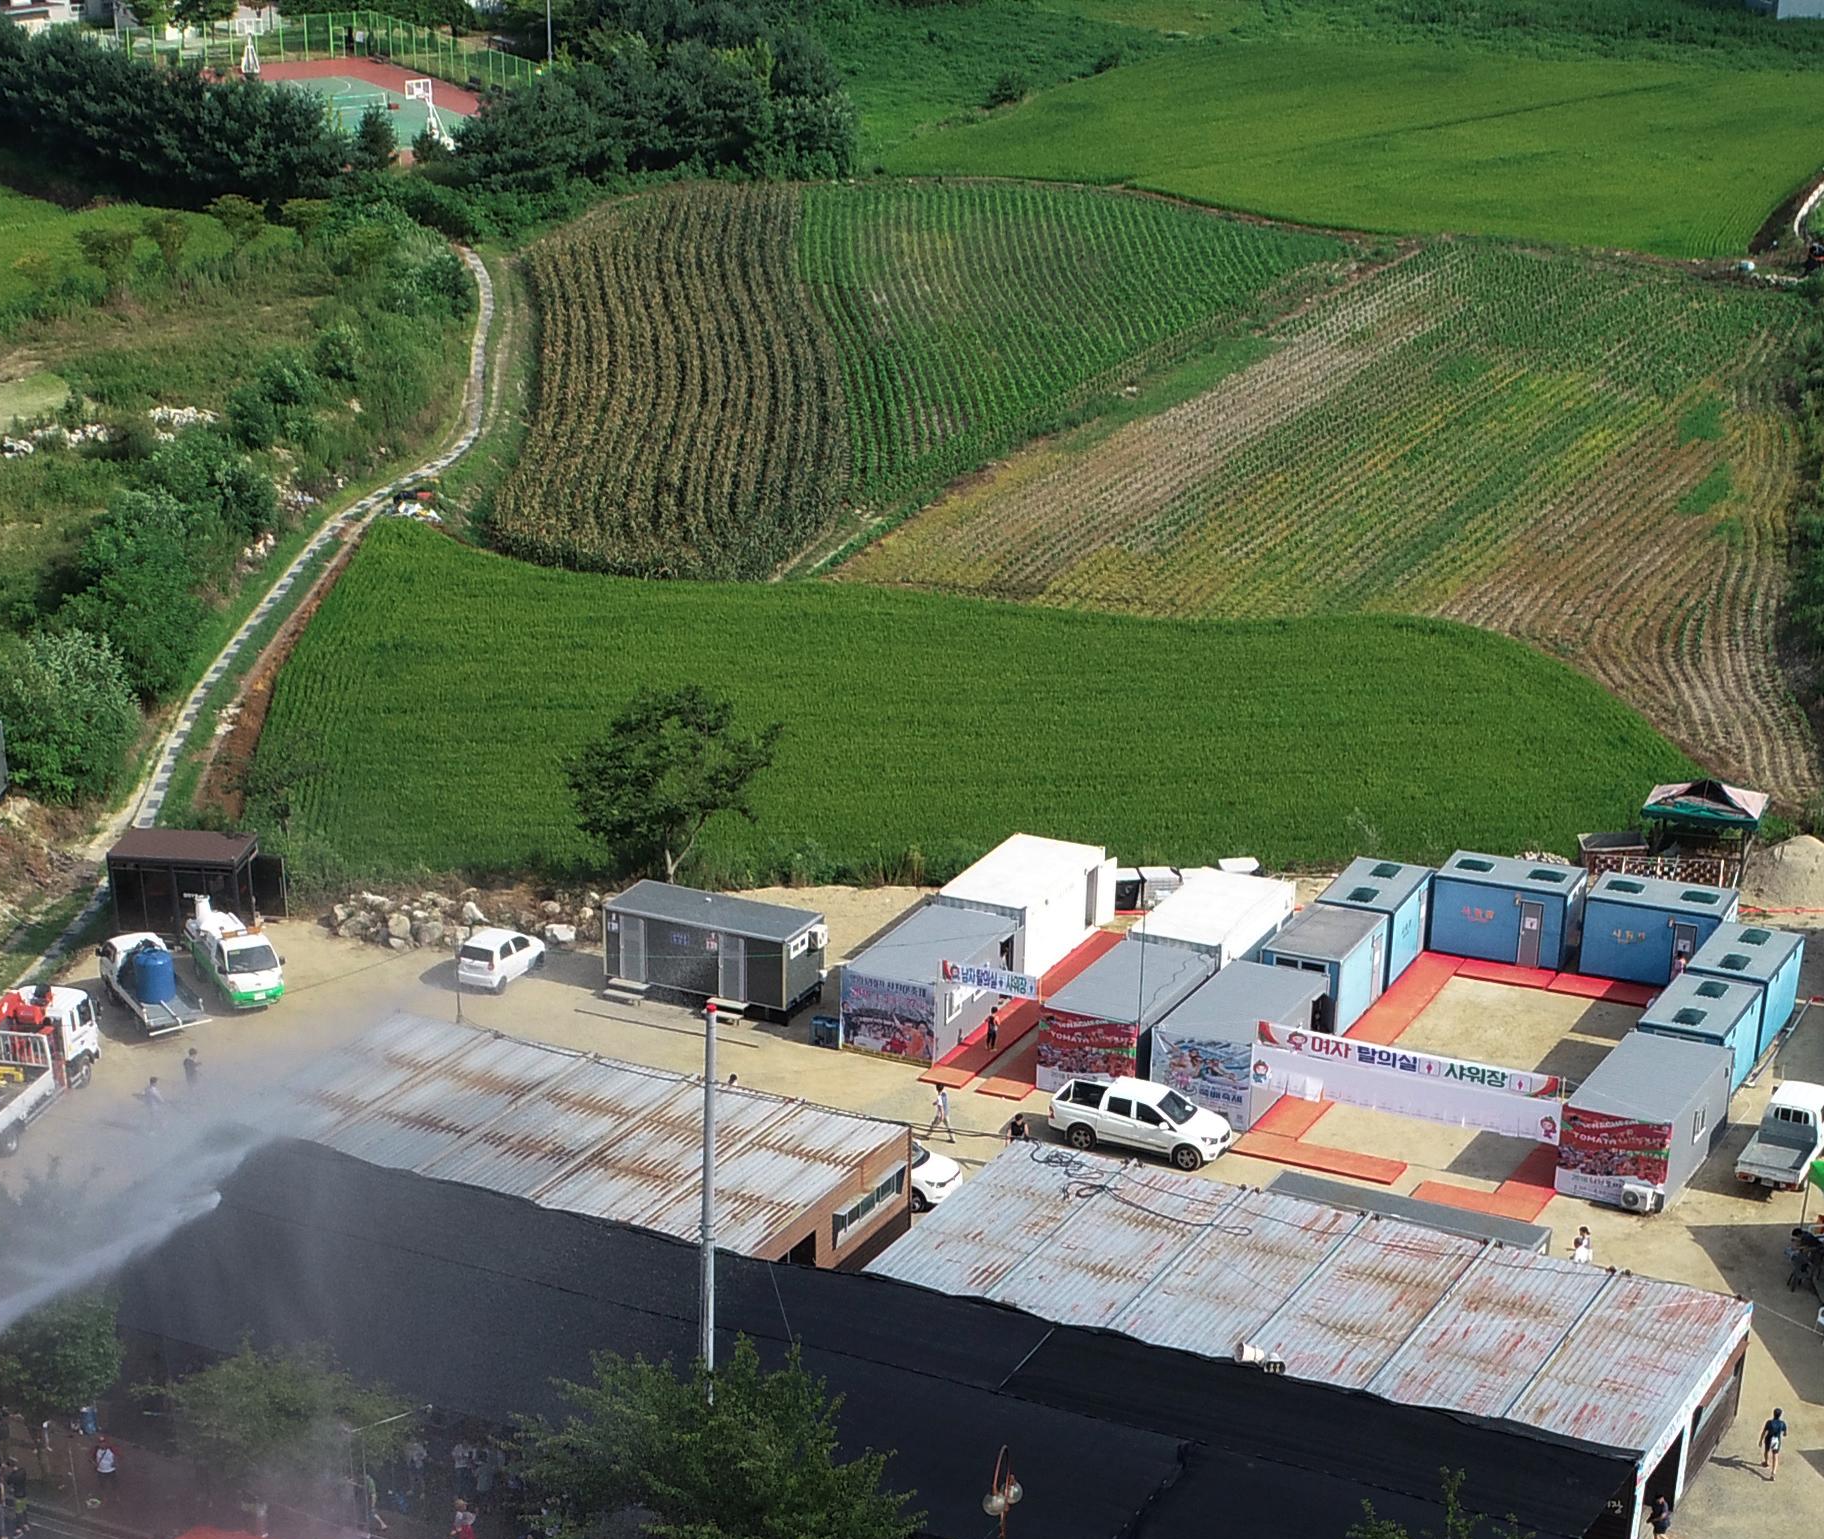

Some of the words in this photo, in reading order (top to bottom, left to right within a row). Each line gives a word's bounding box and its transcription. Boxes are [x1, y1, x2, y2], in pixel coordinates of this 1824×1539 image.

[961, 966, 976, 985] 남자
[976, 967, 997, 989] 탈의실
[1006, 974, 1027, 994] 샤워장
[1310, 1035, 1352, 1059] 여자
[1357, 1045, 1418, 1072] 탈의실
[1444, 1062, 1508, 1088] 샤워장
